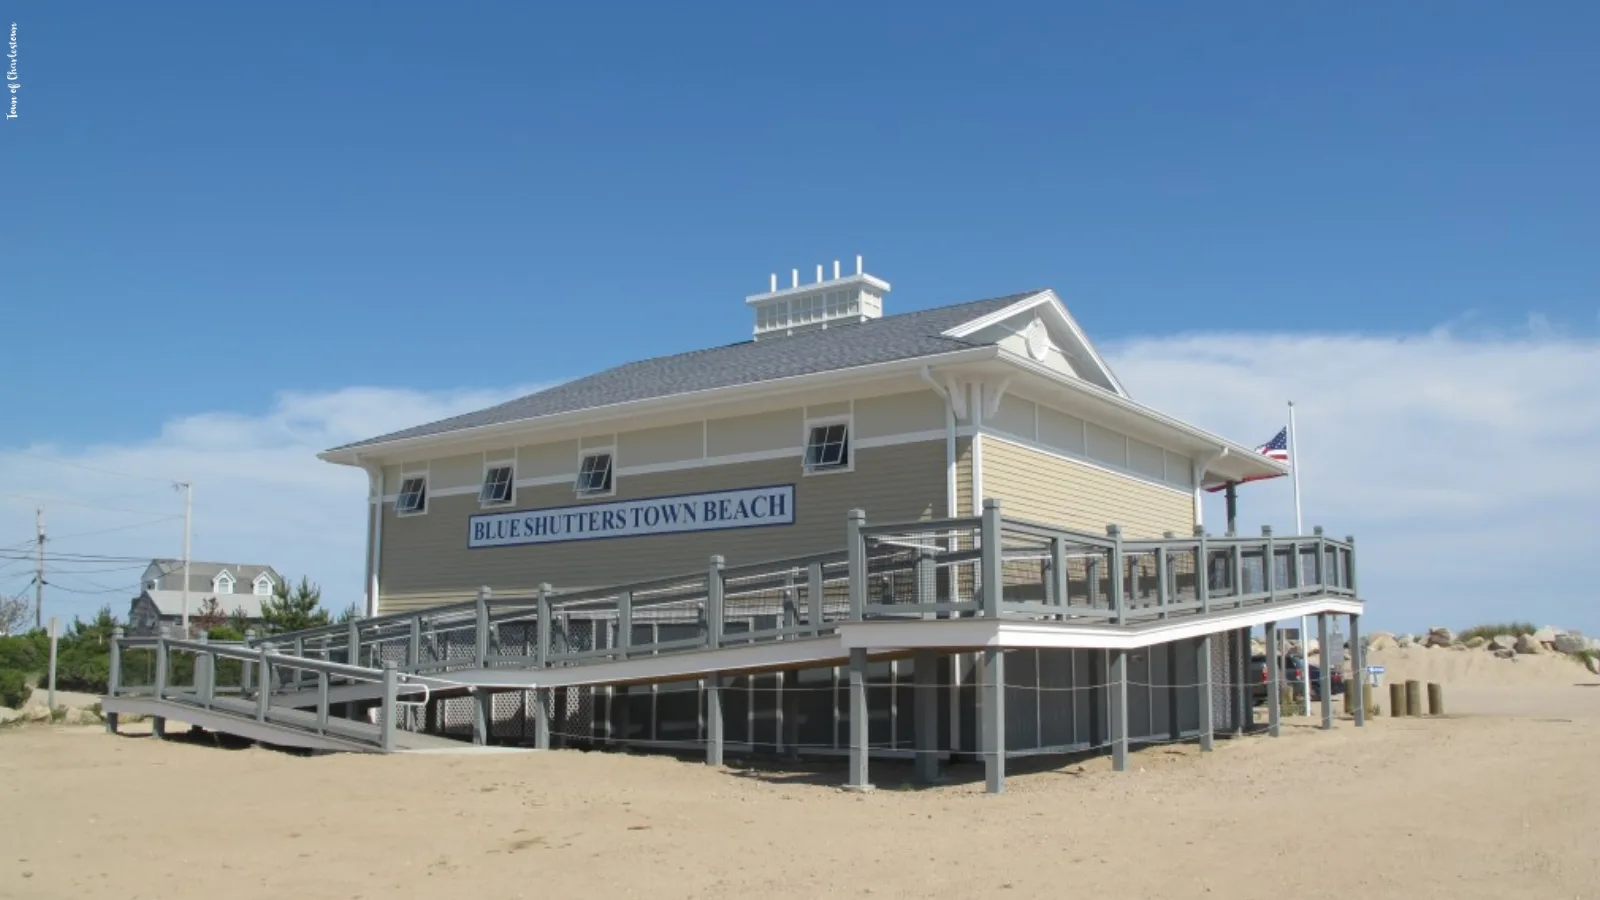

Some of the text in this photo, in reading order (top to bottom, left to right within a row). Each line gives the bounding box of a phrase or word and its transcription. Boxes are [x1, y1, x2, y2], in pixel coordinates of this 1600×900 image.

[474, 493, 786, 541] BLUE SHUTTERS TOWN BEACH
